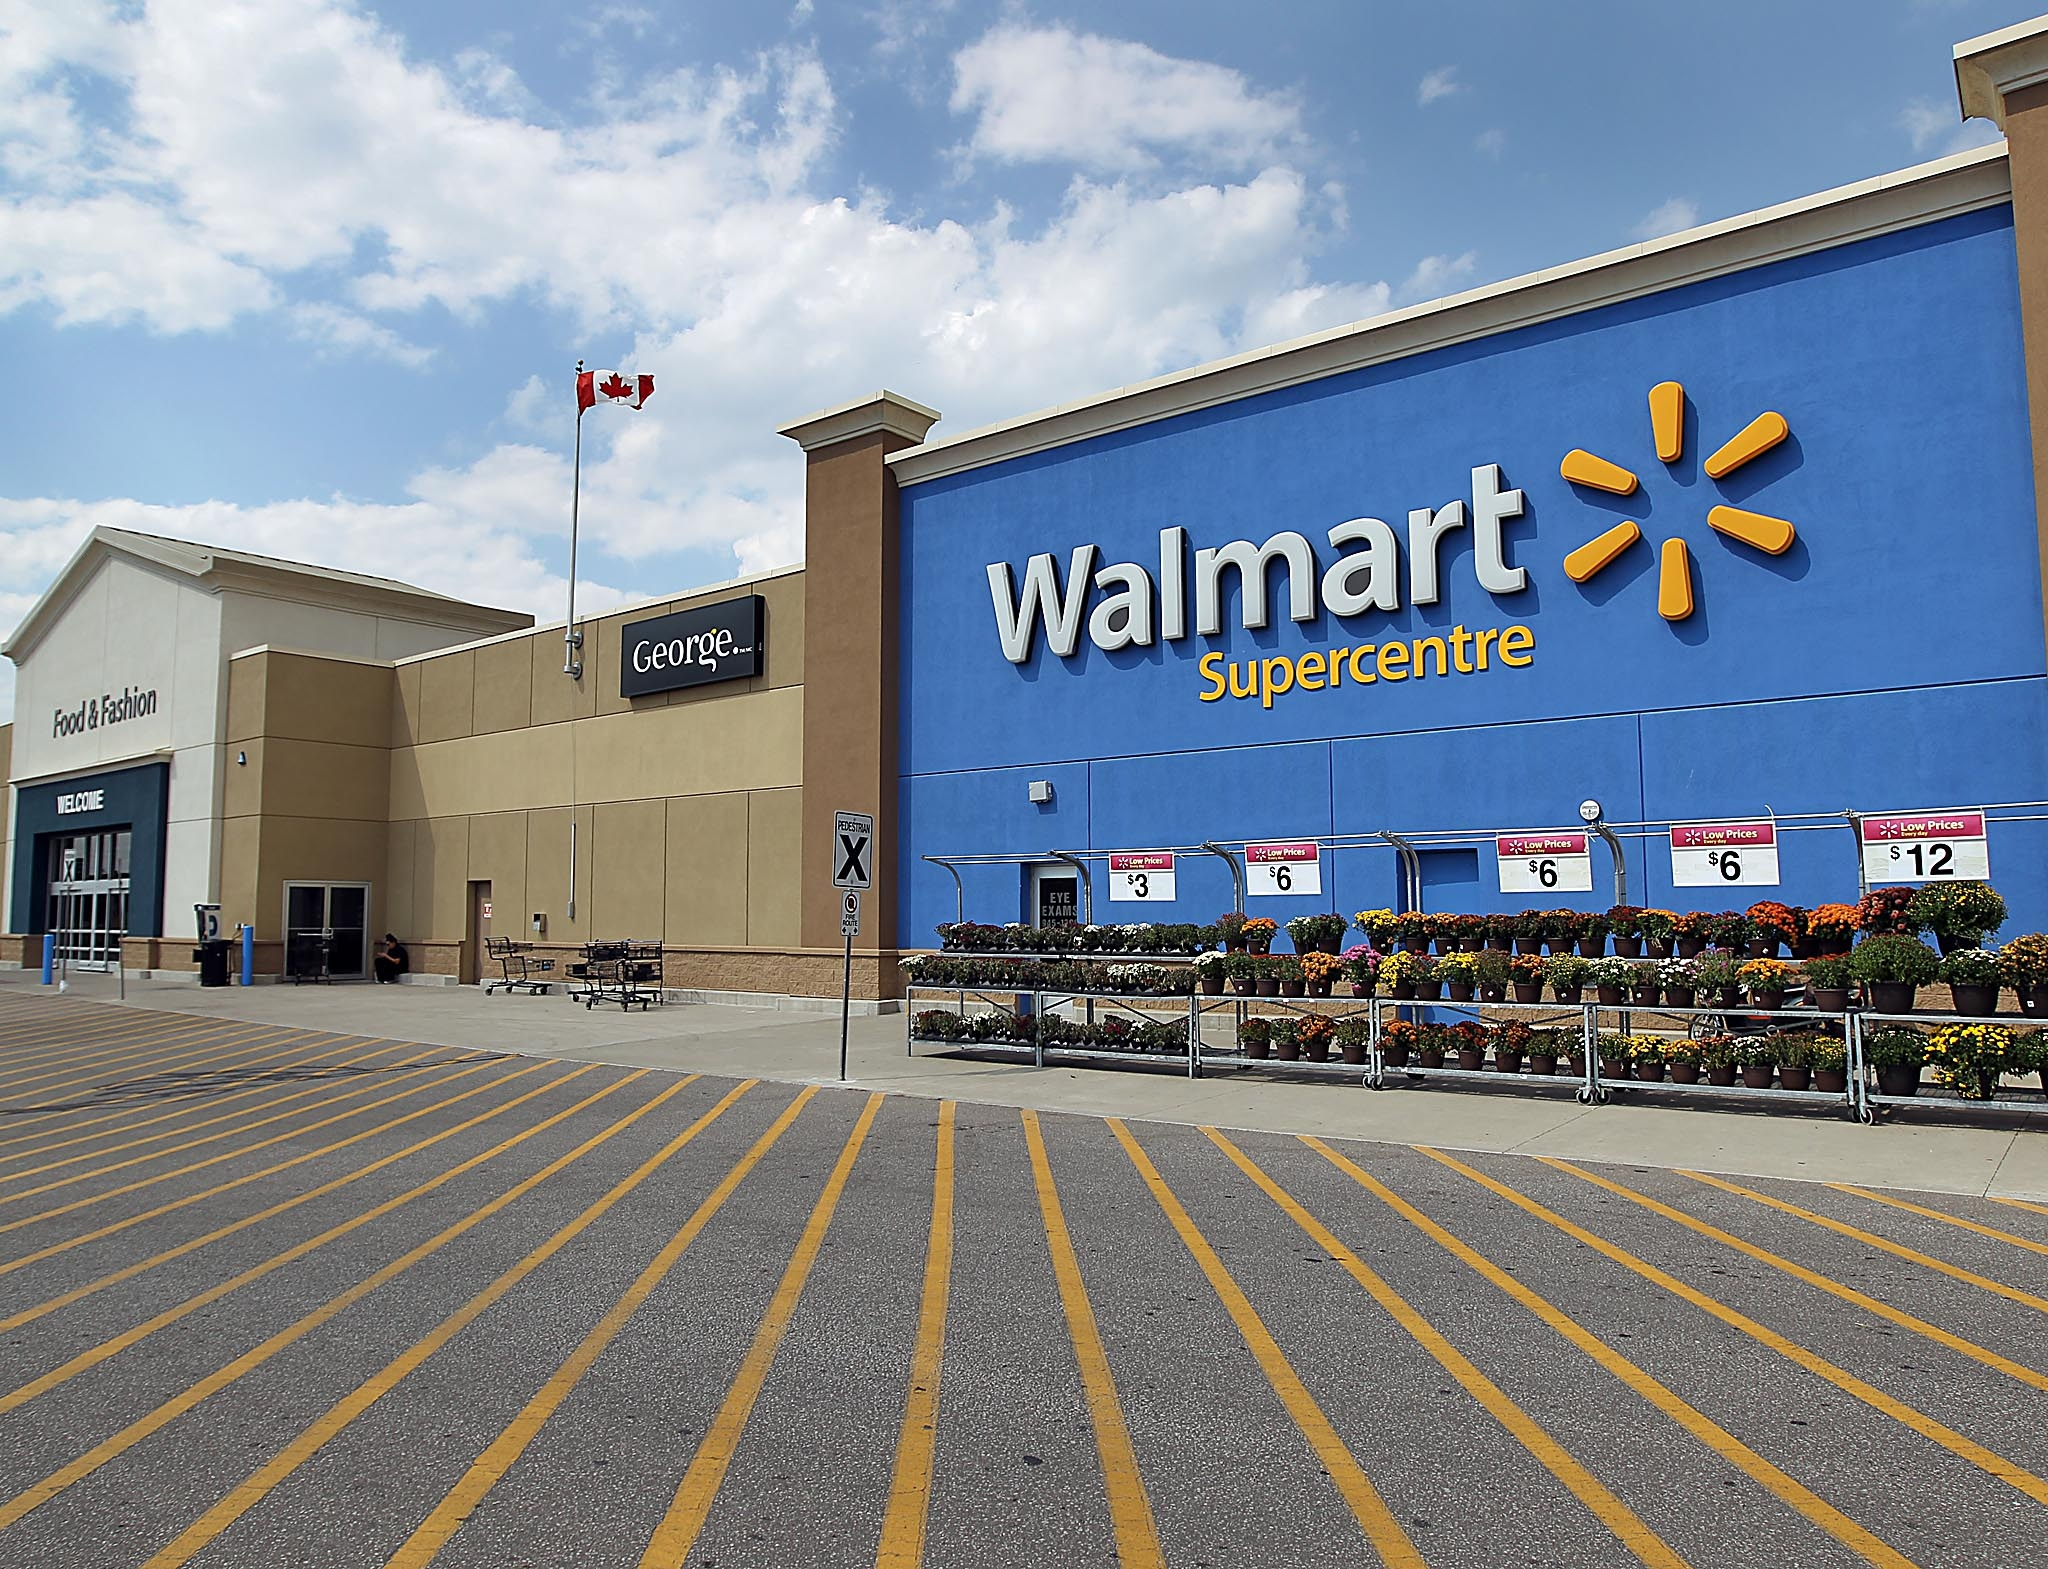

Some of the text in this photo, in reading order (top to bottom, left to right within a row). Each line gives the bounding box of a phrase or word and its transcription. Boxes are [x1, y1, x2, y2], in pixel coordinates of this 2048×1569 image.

[986, 462, 1527, 663] Walmart
[1199, 624, 1534, 709] Supercentre
[53, 686, 157, 739] Food & Fashion
[57, 789, 104, 815] WELCOME
[838, 820, 871, 834] PEDESTRIAN
[1900, 820, 1964, 832] Low Prices
[1702, 829, 1757, 839] Low Prices
[1524, 839, 1572, 849] Low Prices
[836, 834, 869, 882] X
[1283, 848, 1306, 856] Prices
[1130, 856, 1163, 865] Low Prices
[1050, 892, 1070, 904] EYE
[1042, 905, 1077, 917] EXAMS
